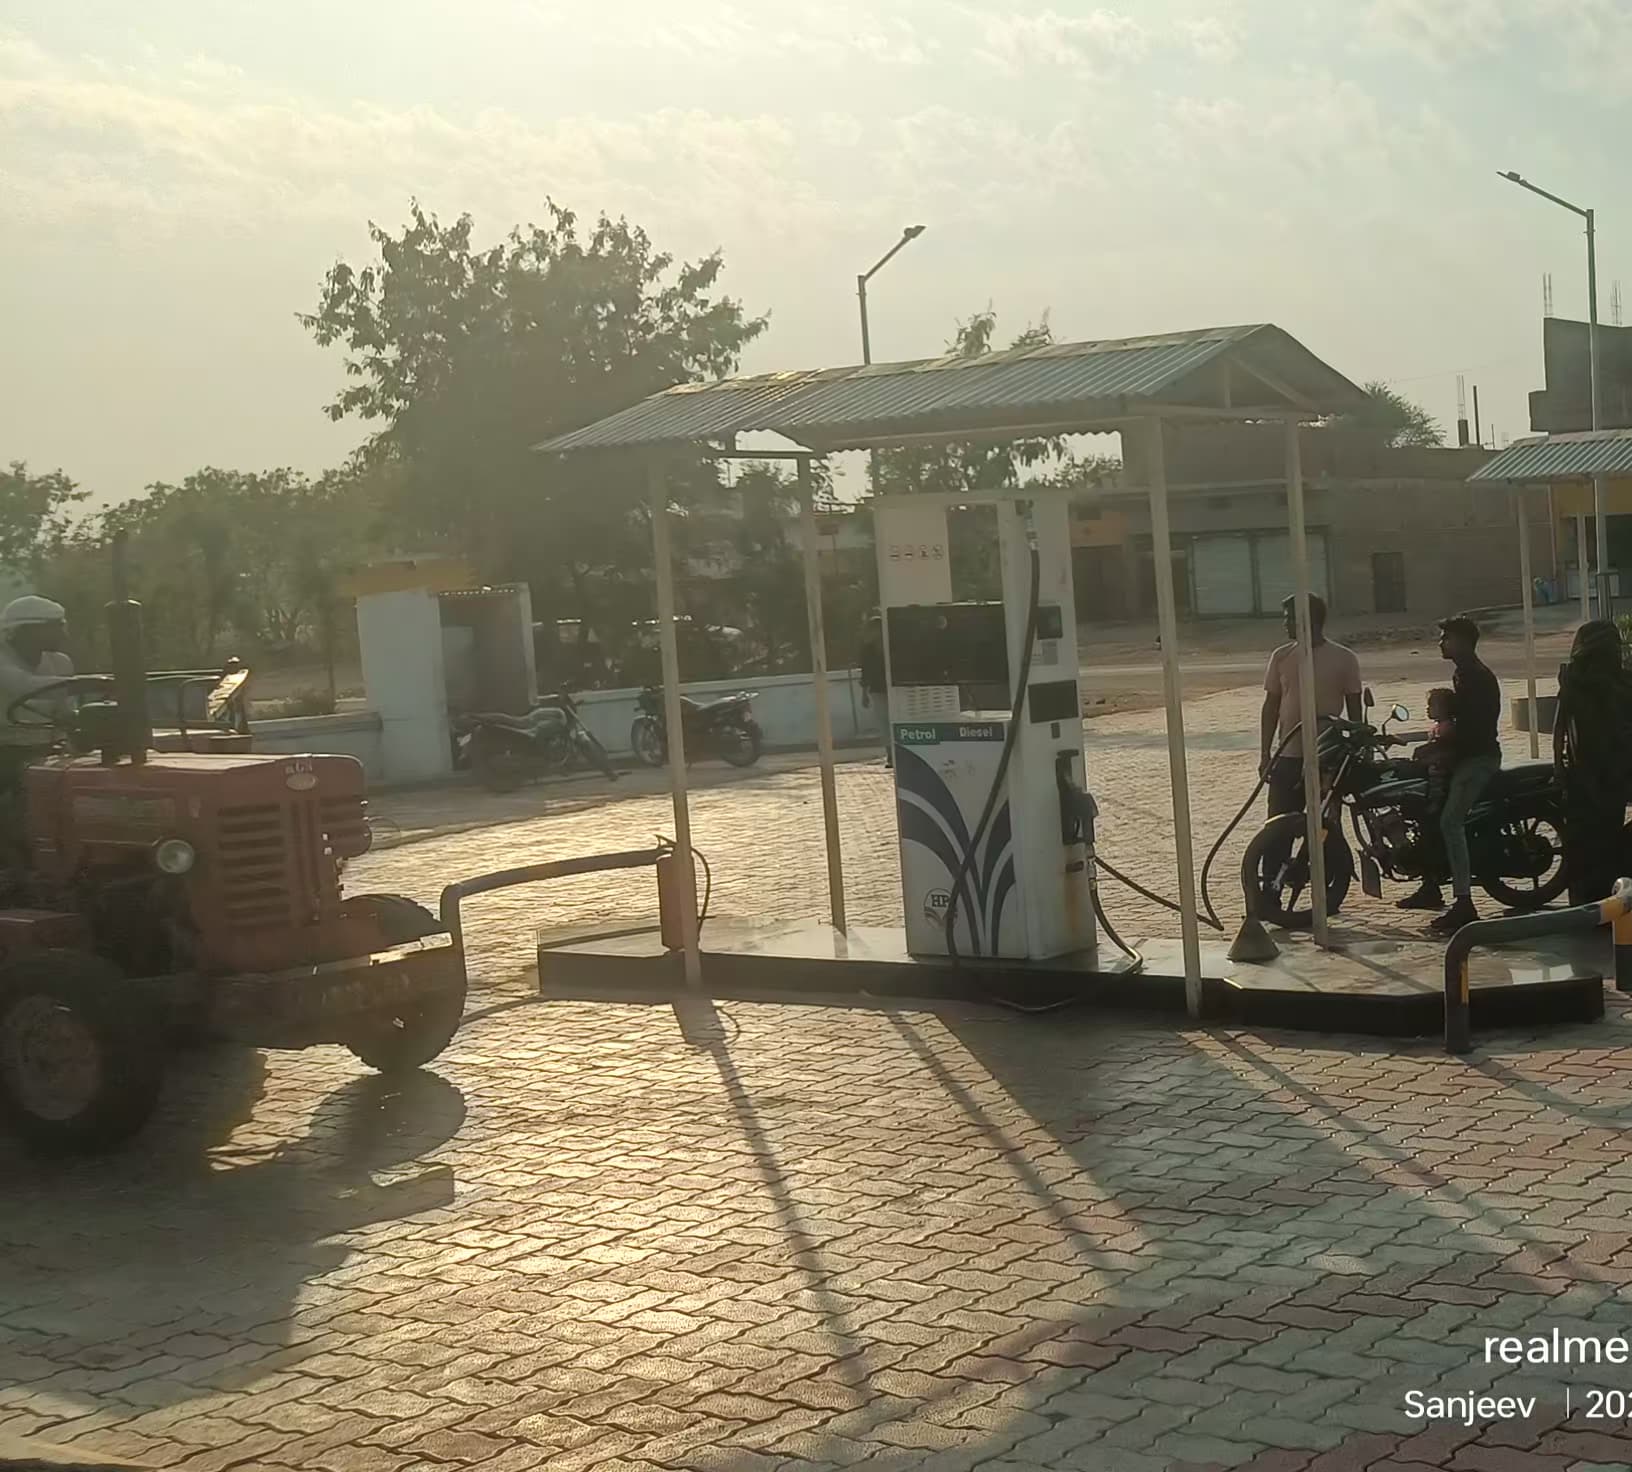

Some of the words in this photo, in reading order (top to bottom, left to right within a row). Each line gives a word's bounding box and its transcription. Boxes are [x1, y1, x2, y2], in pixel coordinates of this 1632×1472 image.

[900, 728, 937, 740] Petrol
[959, 726, 993, 737] Diesel
[931, 894, 950, 907] HP
